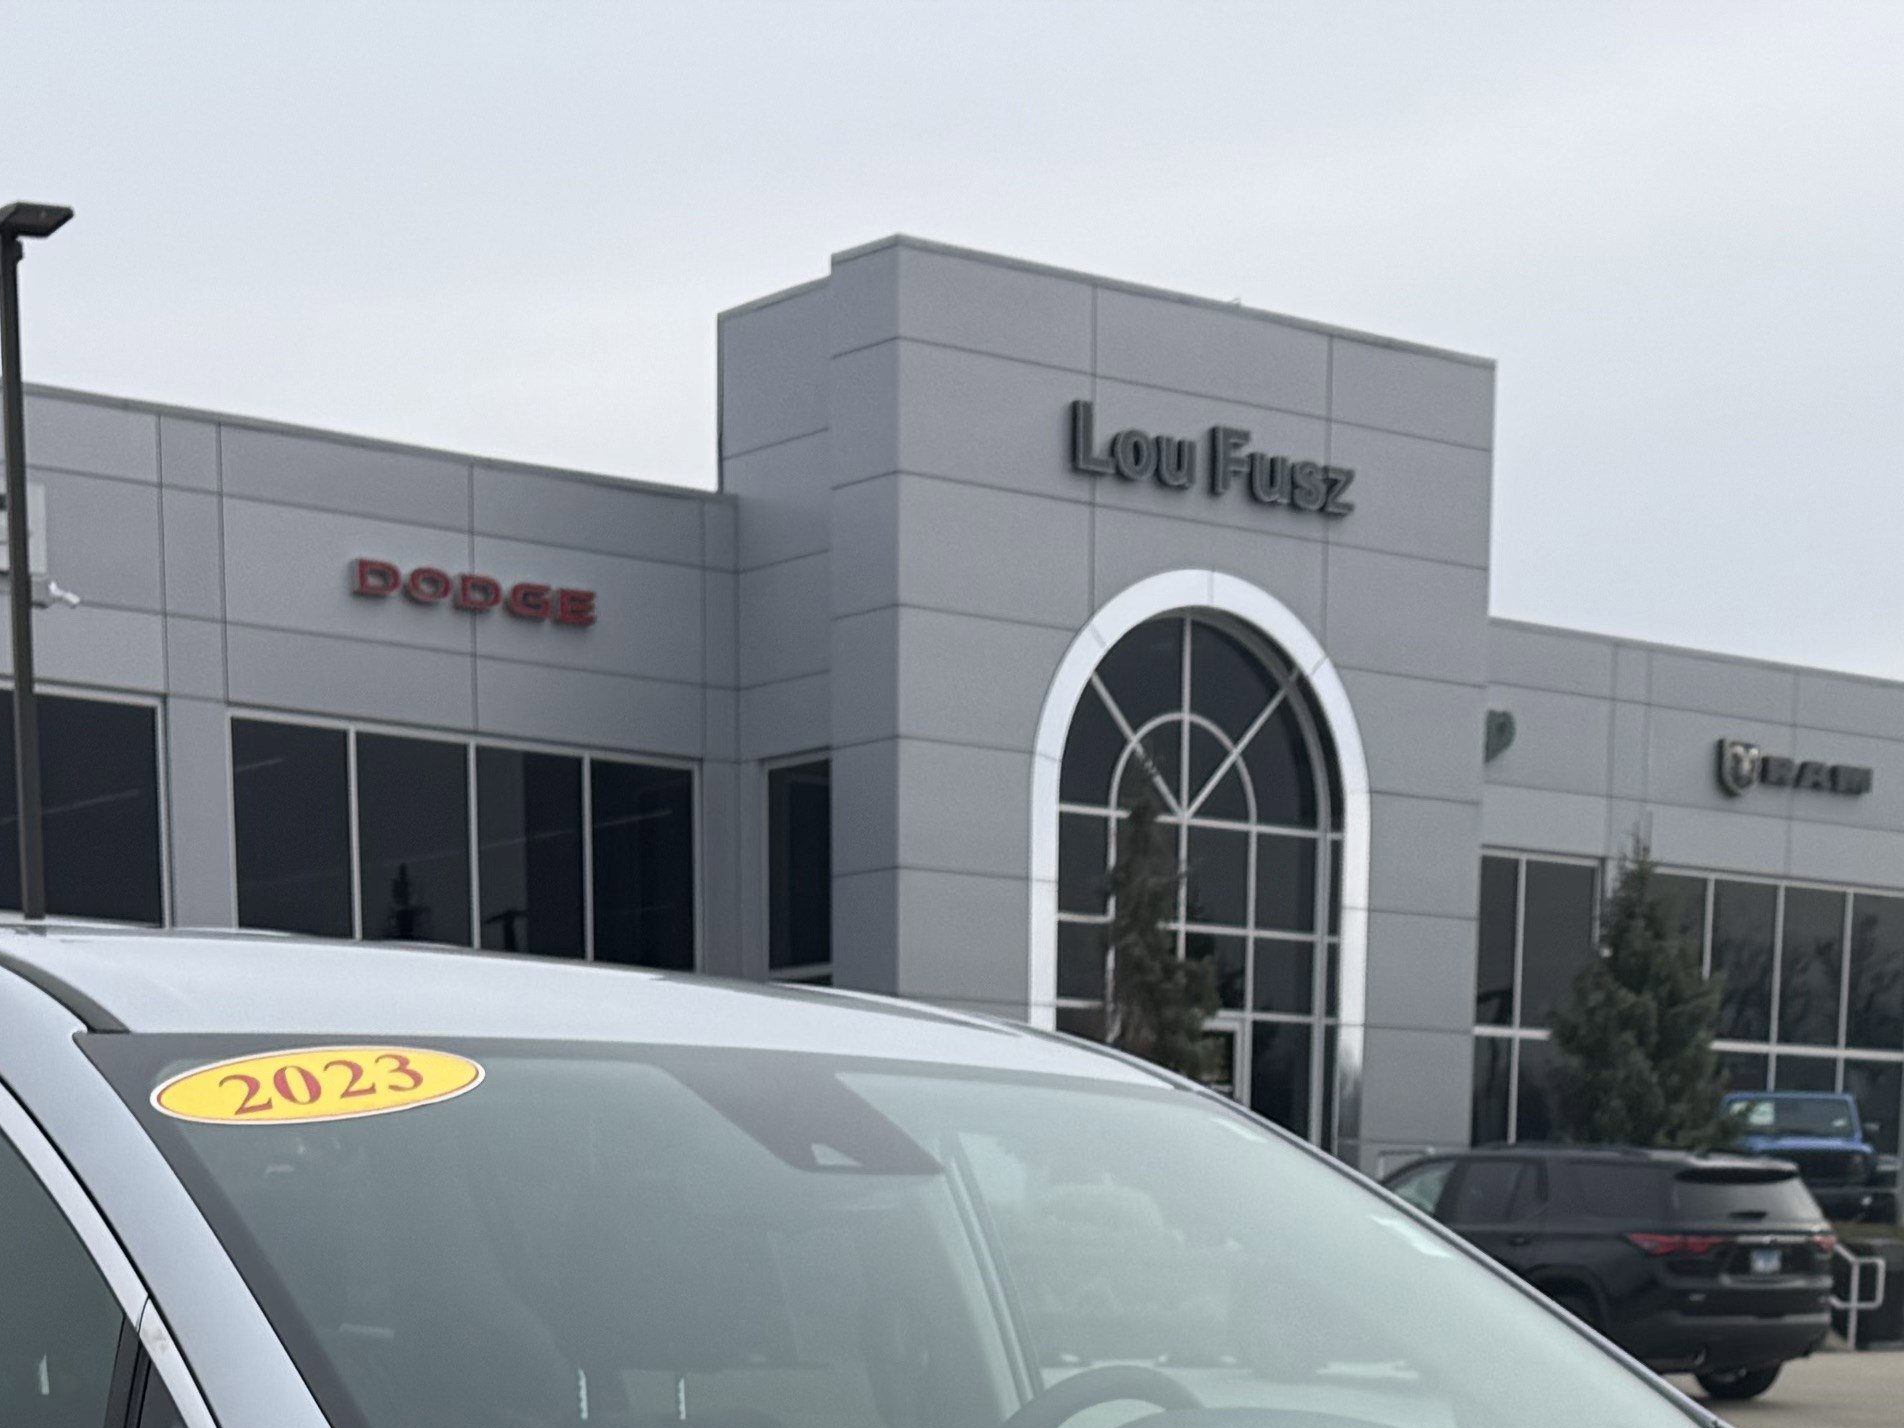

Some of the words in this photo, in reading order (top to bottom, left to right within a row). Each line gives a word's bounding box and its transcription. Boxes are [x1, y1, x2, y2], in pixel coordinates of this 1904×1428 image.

[1069, 399, 1195, 492] Lou
[1207, 425, 1355, 515] Fusz
[350, 558, 597, 627] DODGE
[1760, 755, 1873, 796] RAM
[218, 1054, 424, 1116] 2023
